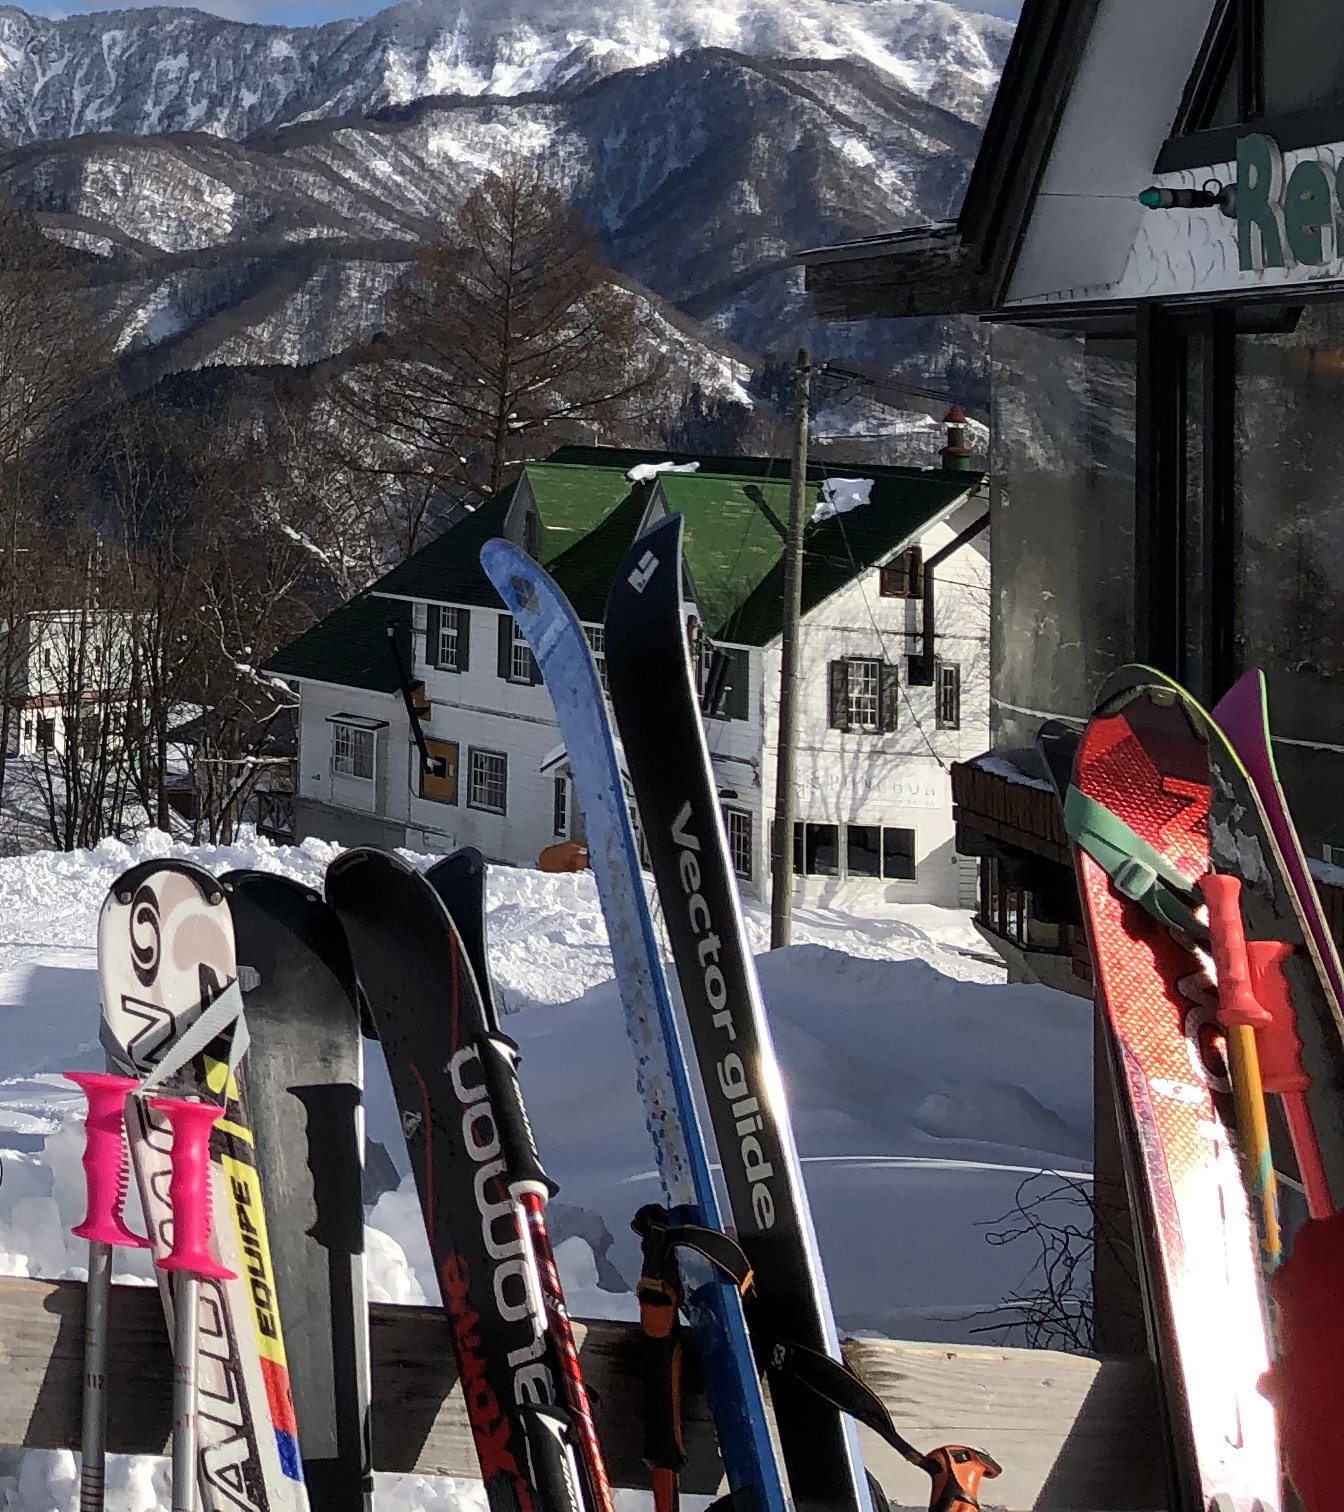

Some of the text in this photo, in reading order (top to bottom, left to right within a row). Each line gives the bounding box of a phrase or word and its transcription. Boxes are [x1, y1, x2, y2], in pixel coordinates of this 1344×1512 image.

[1236, 132, 1344, 272] Re
[670, 799, 777, 1231] Vector glide
[232, 1174, 278, 1343] EQUIPE
[444, 1040, 558, 1408] alomon
